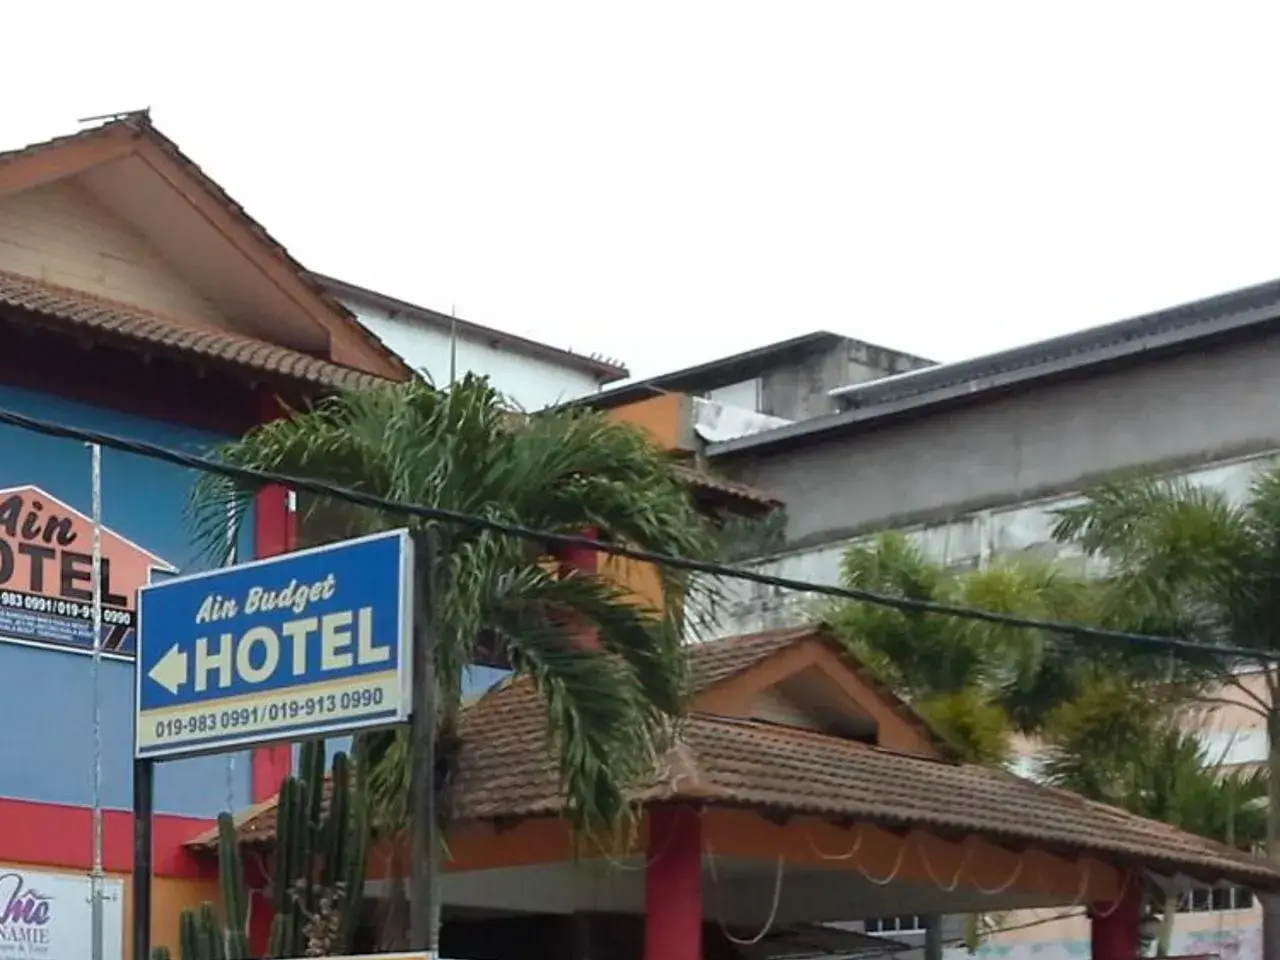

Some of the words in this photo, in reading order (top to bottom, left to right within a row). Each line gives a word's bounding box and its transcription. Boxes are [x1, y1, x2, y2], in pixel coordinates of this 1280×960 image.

[195, 595, 239, 625] Ain
[243, 573, 336, 615] Budget
[194, 605, 390, 693] HOTEL
[155, 712, 217, 738] 019-983
[340, 687, 383, 710] 0990
